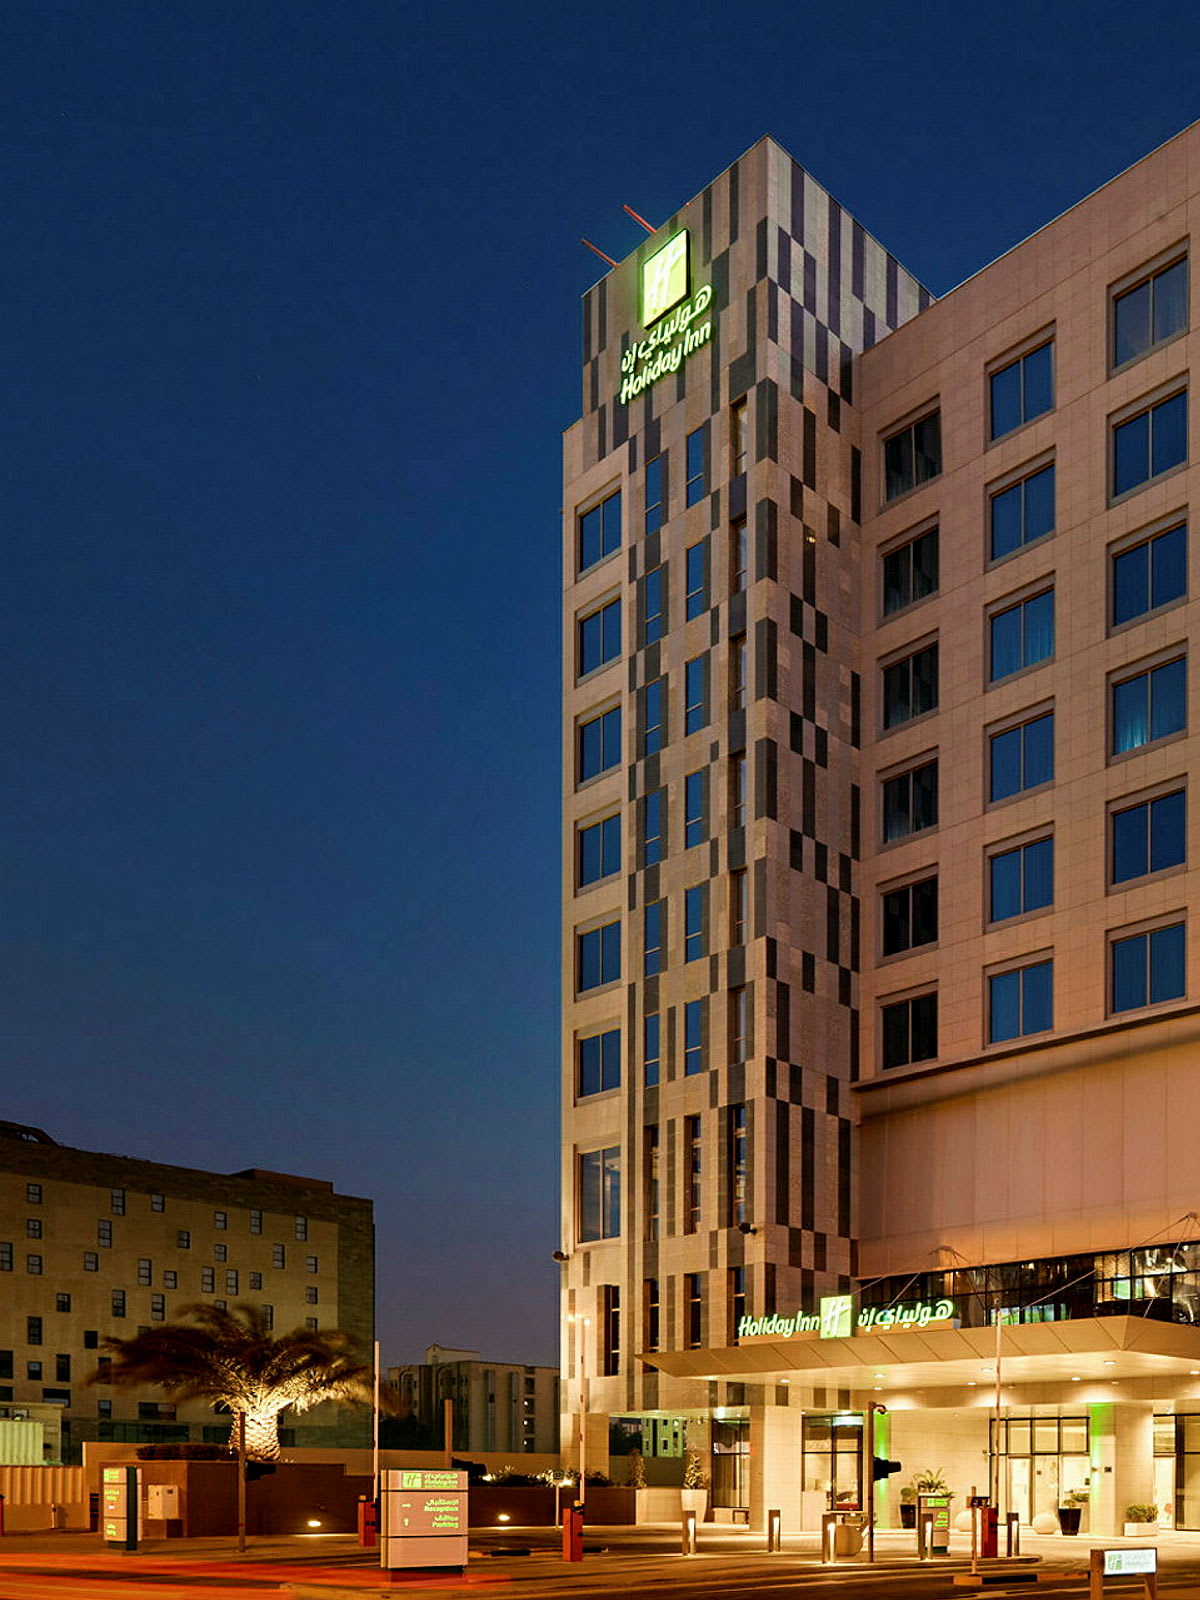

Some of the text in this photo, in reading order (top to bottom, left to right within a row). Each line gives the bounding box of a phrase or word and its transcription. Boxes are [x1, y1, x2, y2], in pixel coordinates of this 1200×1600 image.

[621, 285, 712, 373] هوليداي إن
[620, 322, 711, 405] Holiday Inn
[738, 1309, 820, 1338] Holiday Inn
[857, 1299, 954, 1332] هوليداي إن
